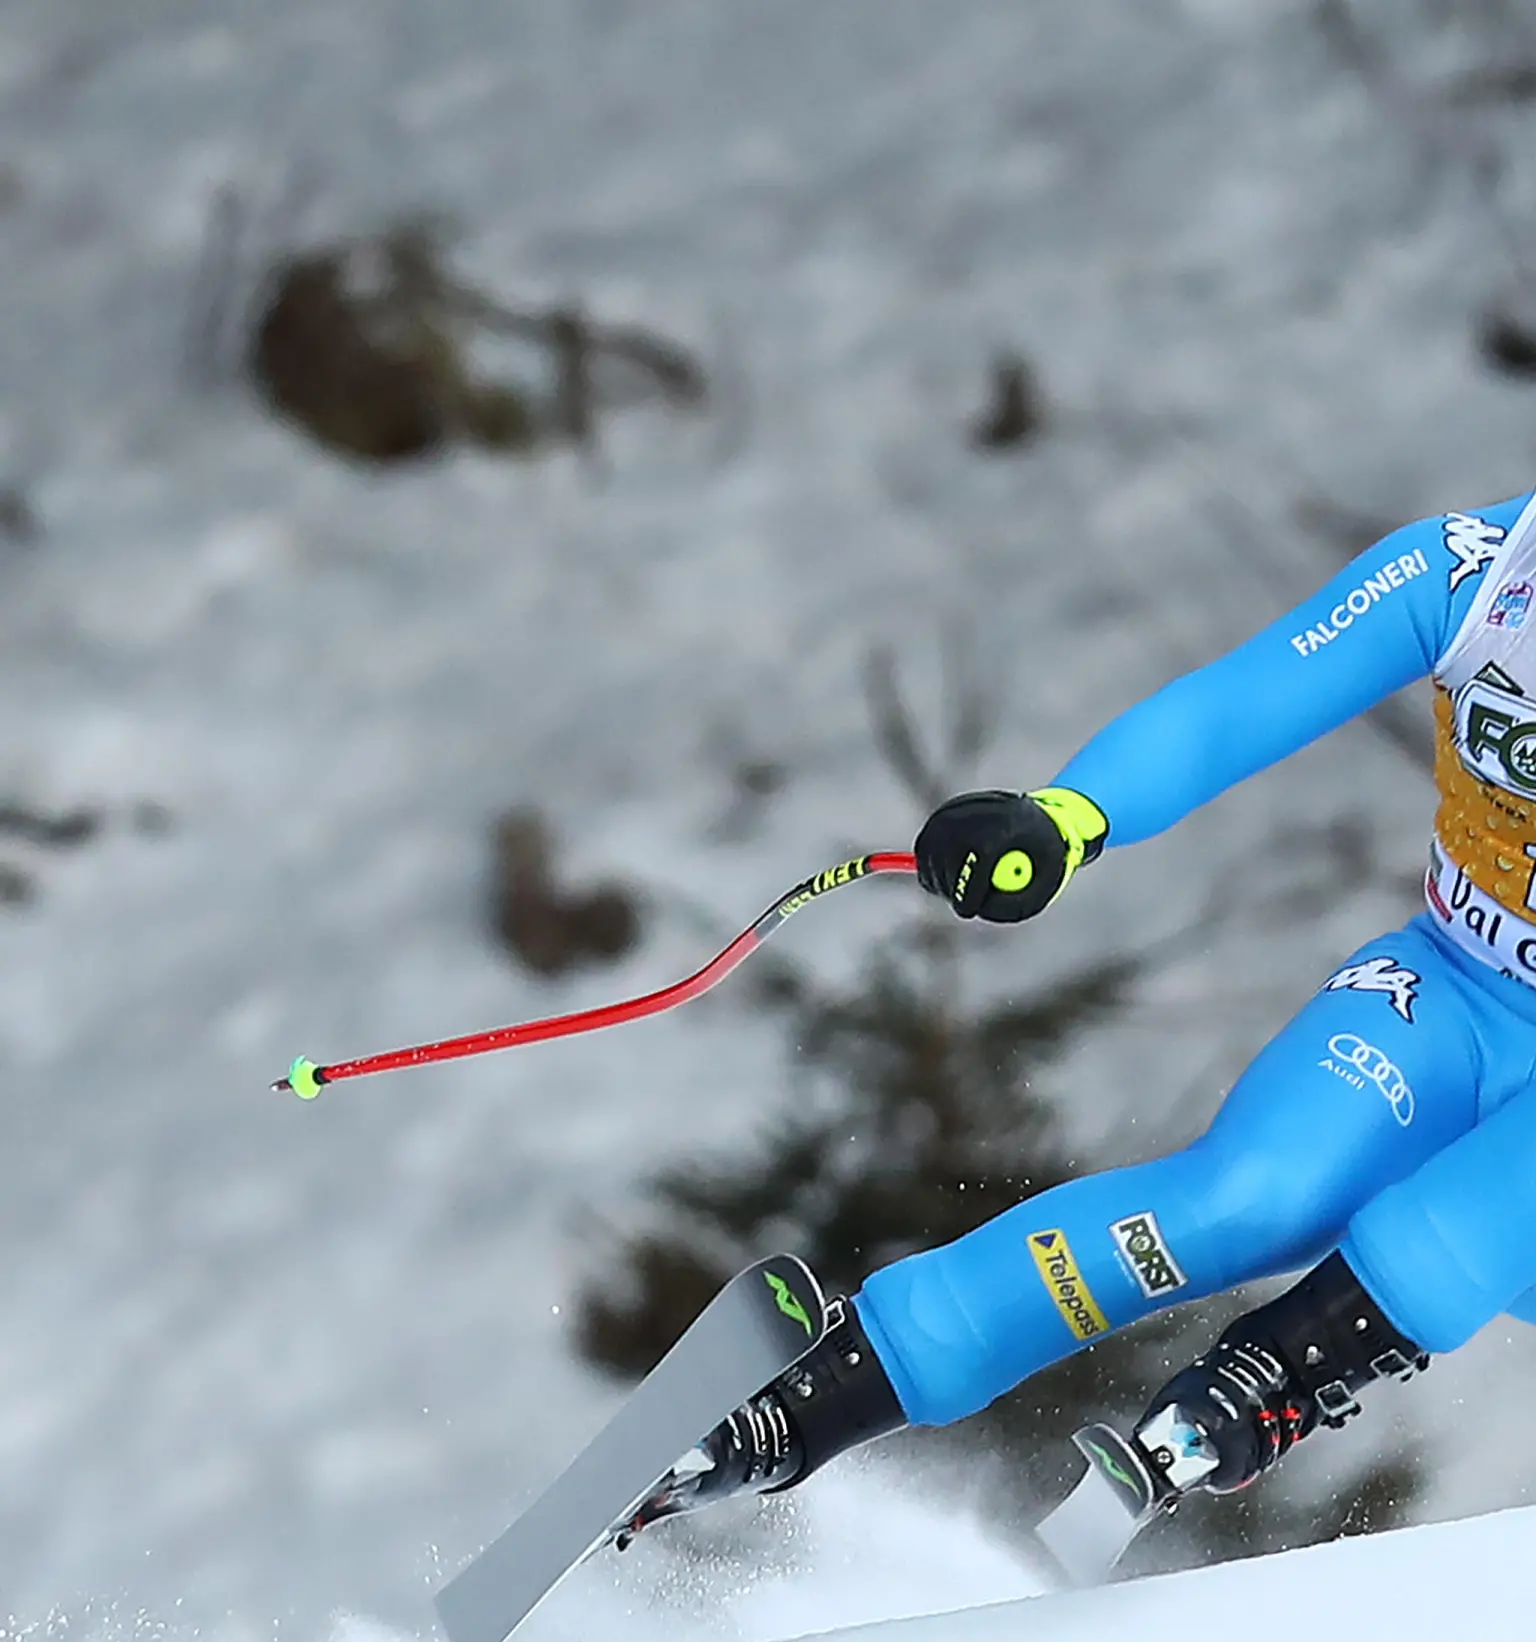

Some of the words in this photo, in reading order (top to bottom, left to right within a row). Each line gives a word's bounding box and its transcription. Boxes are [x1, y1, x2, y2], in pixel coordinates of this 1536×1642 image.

[1290, 549, 1430, 657] FALCONERI
[812, 856, 866, 892] LEKI
[956, 851, 978, 902] LEKI
[1451, 866, 1502, 947] Val
[1317, 1057, 1366, 1092] Audi
[1119, 1217, 1181, 1291] FORST
